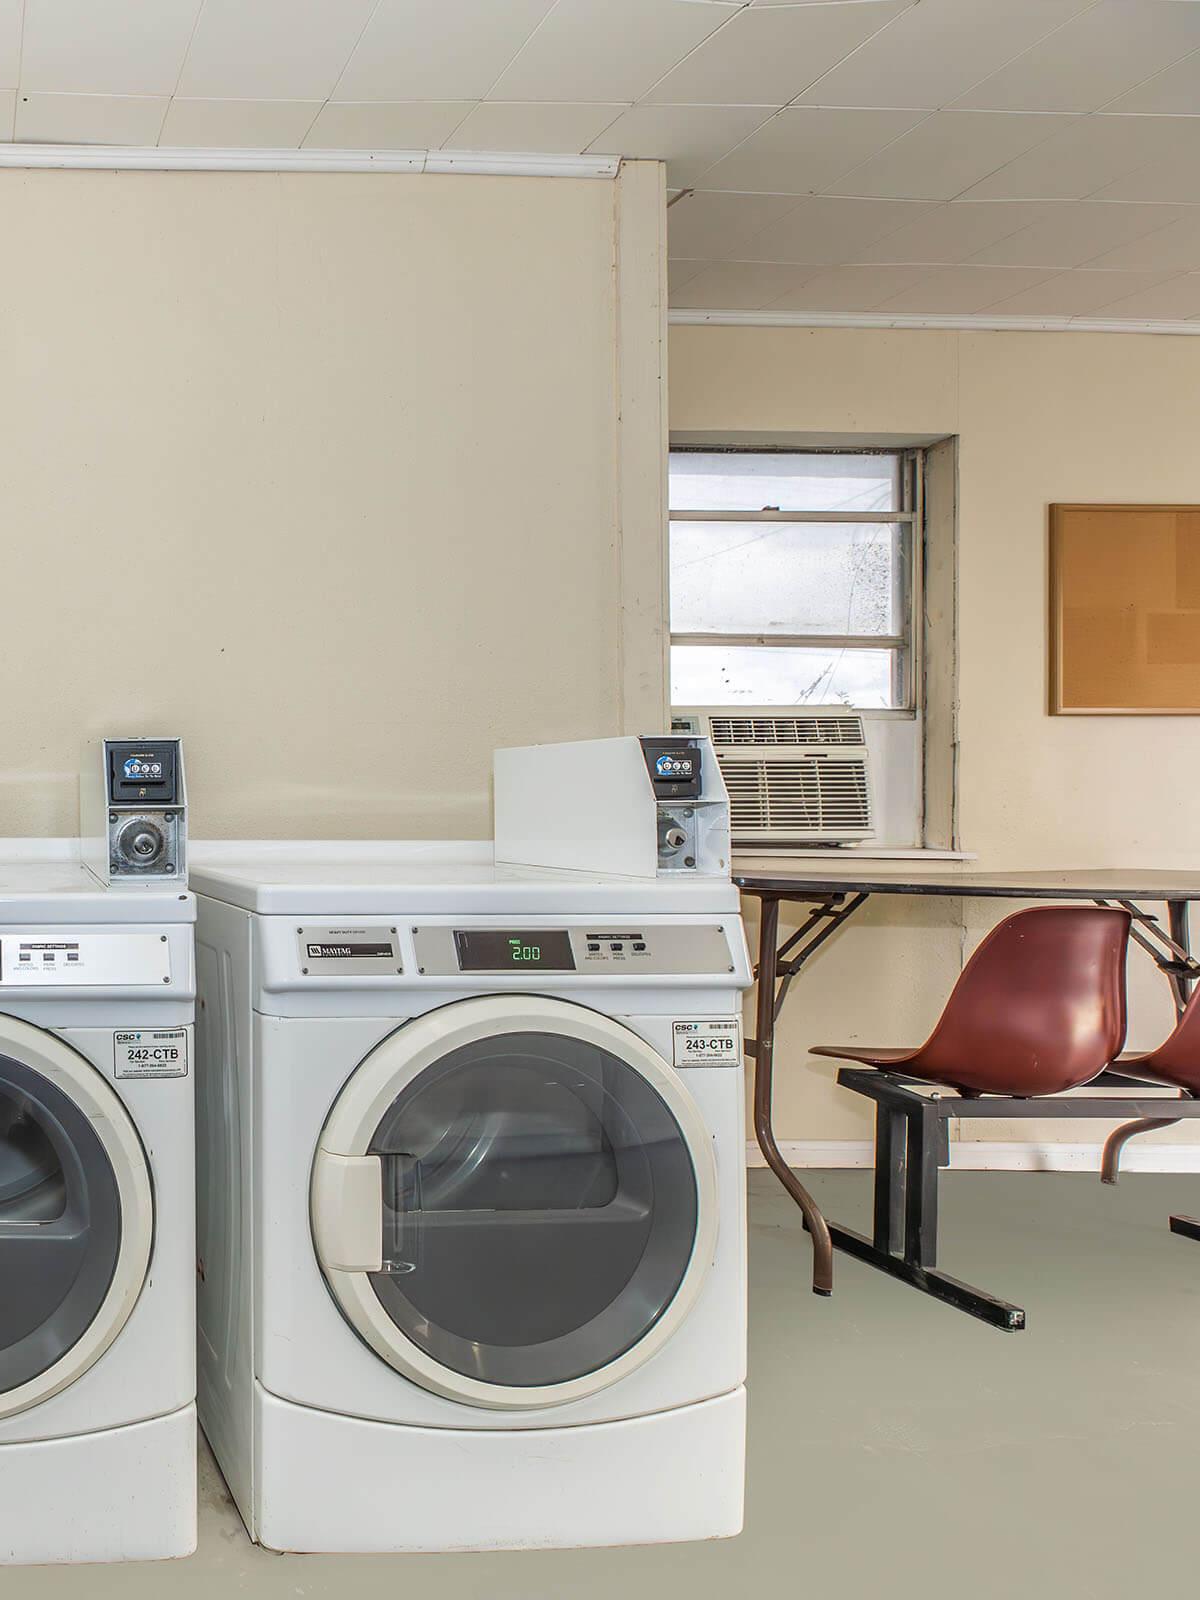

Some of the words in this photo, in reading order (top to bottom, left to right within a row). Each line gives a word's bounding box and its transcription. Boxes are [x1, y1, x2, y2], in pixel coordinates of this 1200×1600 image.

[512, 946, 540, 960] 2.00
[686, 1039, 733, 1050] 243-CTB
[127, 1049, 179, 1060] 242-CTB
